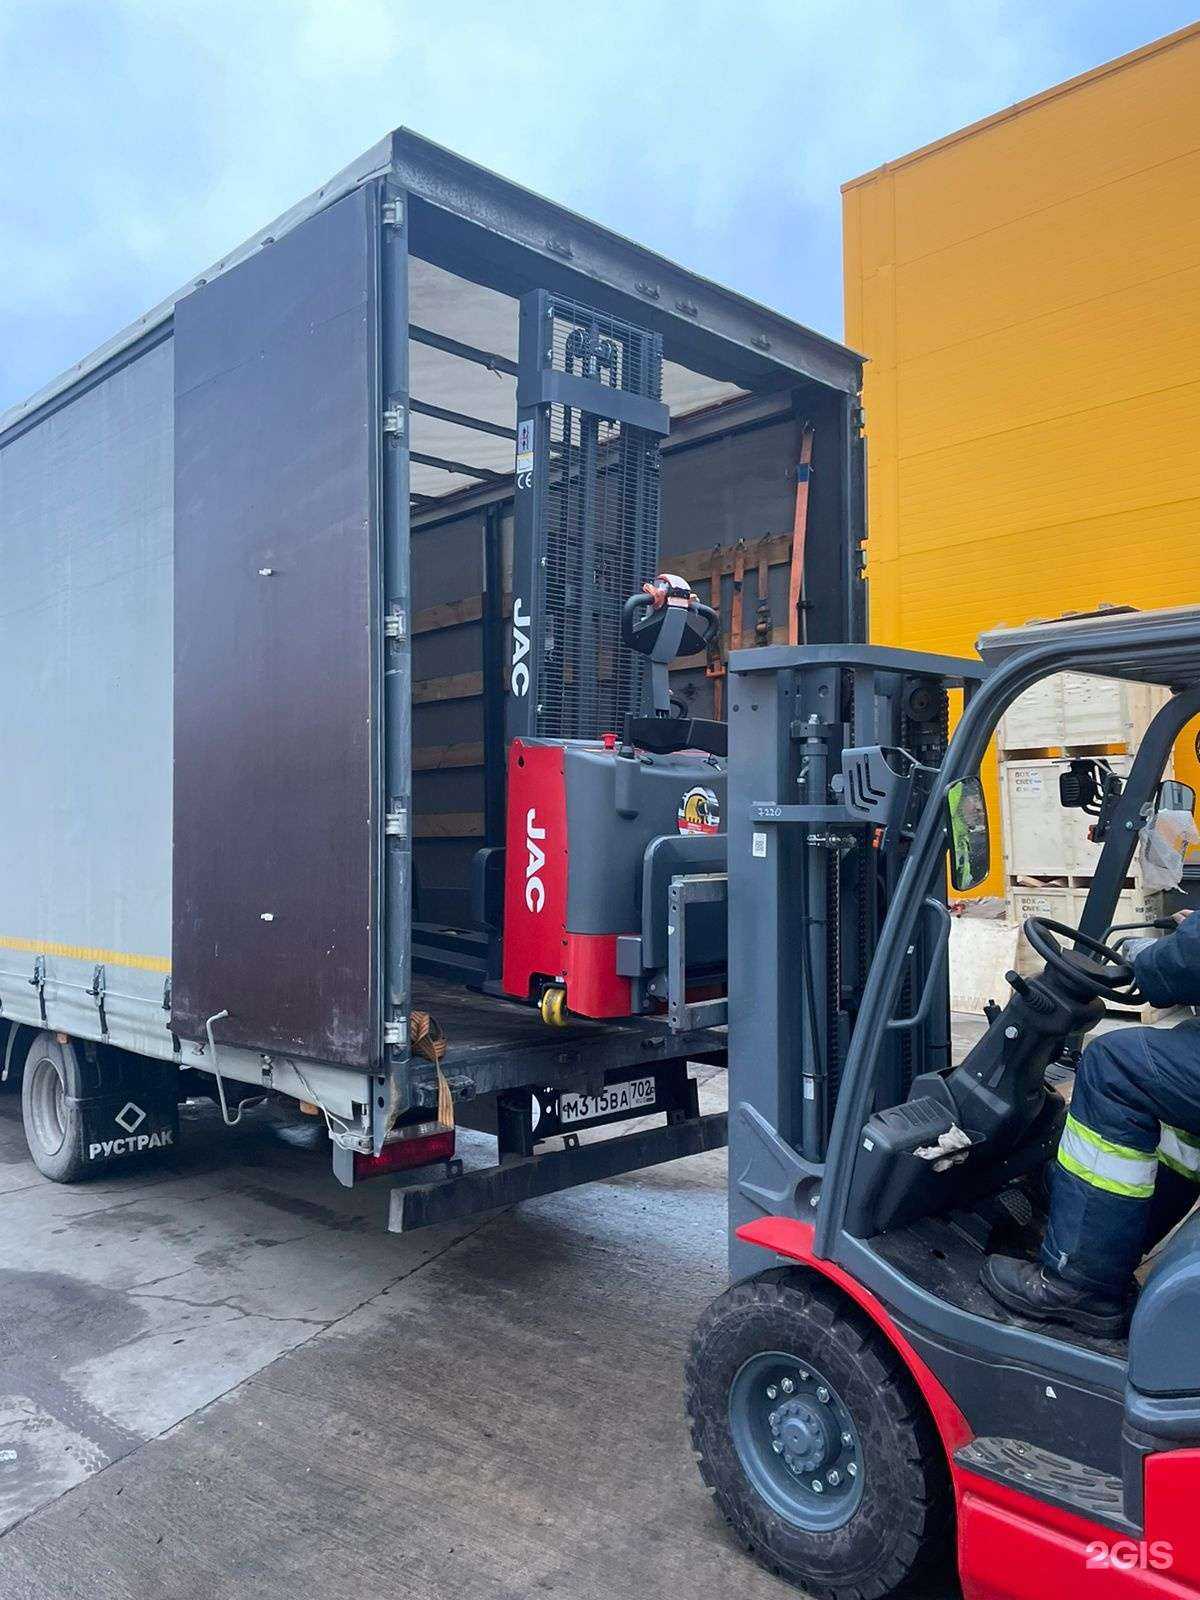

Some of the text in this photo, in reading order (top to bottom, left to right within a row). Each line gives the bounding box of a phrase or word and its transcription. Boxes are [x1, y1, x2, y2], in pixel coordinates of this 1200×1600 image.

[511, 598, 531, 697] JAC
[525, 808, 546, 913] JAC
[630, 1080, 652, 1099] 702
[89, 1129, 174, 1160] РУСТРАК
